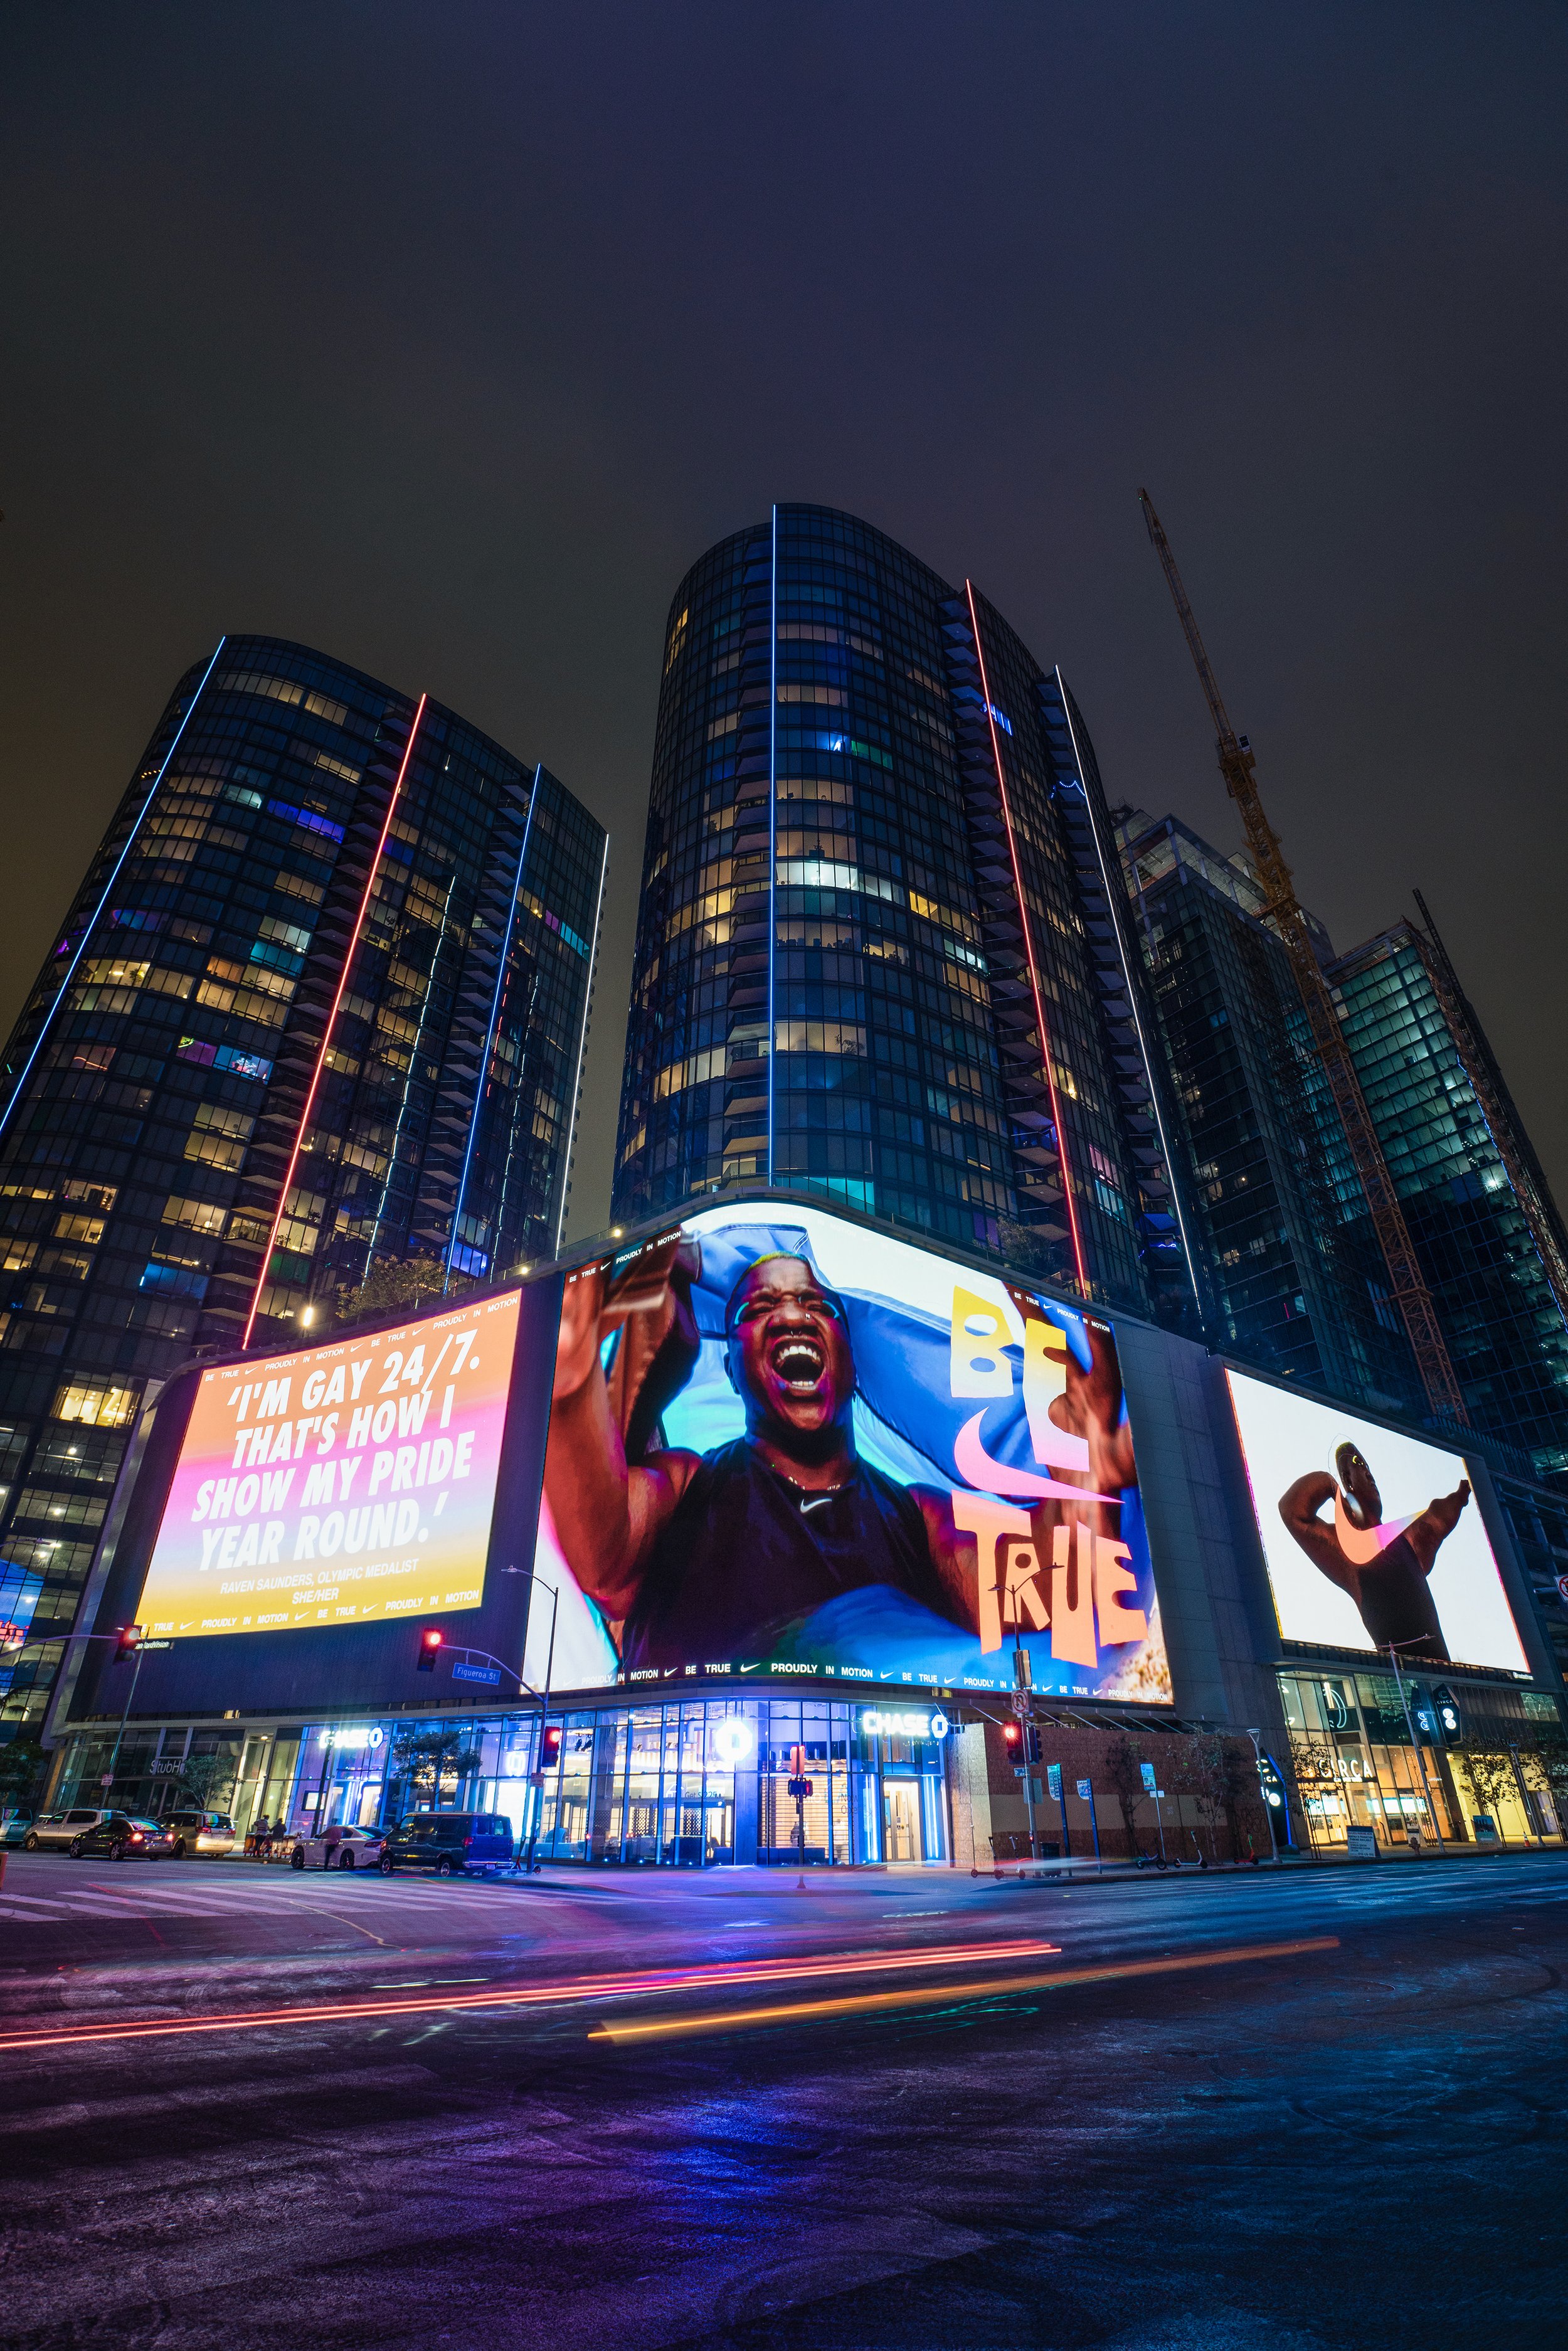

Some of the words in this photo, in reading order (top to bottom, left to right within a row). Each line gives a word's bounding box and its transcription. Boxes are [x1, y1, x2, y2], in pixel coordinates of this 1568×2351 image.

[569, 1275, 577, 1283] BE
[581, 1267, 596, 1278] TRUE
[616, 1248, 642, 1265] PROUDLY
[647, 1243, 653, 1251] IN
[657, 1230, 681, 1246] MOTION
[1014, 1292, 1022, 1300] BE
[1025, 1296, 1040, 1307] TRUE
[1057, 1308, 1079, 1321] PROUDLY
[1091, 1320, 1110, 1332] MOTION
[205, 1374, 215, 1382] BE
[221, 1369, 240, 1379] TRUE
[265, 1358, 298, 1371] PROUDLY
[302, 1355, 310, 1364] IN
[315, 1347, 345, 1361] MOTION
[371, 1338, 381, 1347] BE
[387, 1331, 406, 1343] TRUE
[433, 1313, 467, 1330] PROUDLY
[473, 1308, 481, 1318] IN
[487, 1296, 518, 1313] MOTION
[301, 1358, 373, 1410] GAY
[378, 1329, 480, 1394] 24/7.
[950, 1285, 1089, 1472] BE
[231, 1412, 339, 1469] THAT'S
[346, 1389, 434, 1449] HOW
[439, 1384, 455, 1429] I
[191, 1468, 297, 1522] SHOW
[299, 1456, 363, 1508] MY
[368, 1430, 475, 1497] PRIDE
[199, 1519, 285, 1571] YEAR
[220, 1580, 255, 1595] RAVEN
[256, 1573, 314, 1591] SAUNDERS,
[317, 1566, 363, 1584] OLYMPIC
[365, 1558, 420, 1578] MEDALIST
[292, 1587, 339, 1605] SHE/HER
[951, 1489, 1148, 1669] TRUE
[141, 1623, 147, 1633] E
[154, 1622, 174, 1632] TRUE
[201, 1617, 238, 1629] PROUDLY
[243, 1616, 252, 1625] IN
[257, 1612, 289, 1625] MOTION
[317, 1609, 329, 1619] BE
[336, 1606, 357, 1617] TRUE
[385, 1597, 423, 1611] PROUDLY
[430, 1595, 439, 1606] IN
[445, 1589, 480, 1603] MOTION
[457, 1667, 487, 1679] Figueroa
[489, 1672, 497, 1680] St
[581, 1674, 613, 1685] PROUDLY
[617, 1673, 625, 1682] IN
[630, 1669, 659, 1681] MOTION
[685, 1665, 697, 1675] BE
[704, 1663, 731, 1674] TRUE
[771, 1663, 818, 1674] PROUDLY
[825, 1665, 835, 1675] IN
[841, 1667, 873, 1678] MOTION
[902, 1672, 912, 1681] BE
[918, 1673, 938, 1683] TRUE
[963, 1677, 994, 1687] PROUDLY
[1000, 1680, 1007, 1689] IN
[1059, 1685, 1068, 1694] BE
[1072, 1686, 1088, 1695] TRUE
[1108, 1689, 1133, 1698] PROUDLY
[863, 1712, 930, 1736] CHASE
[1318, 1759, 1374, 1778] CIRCA
